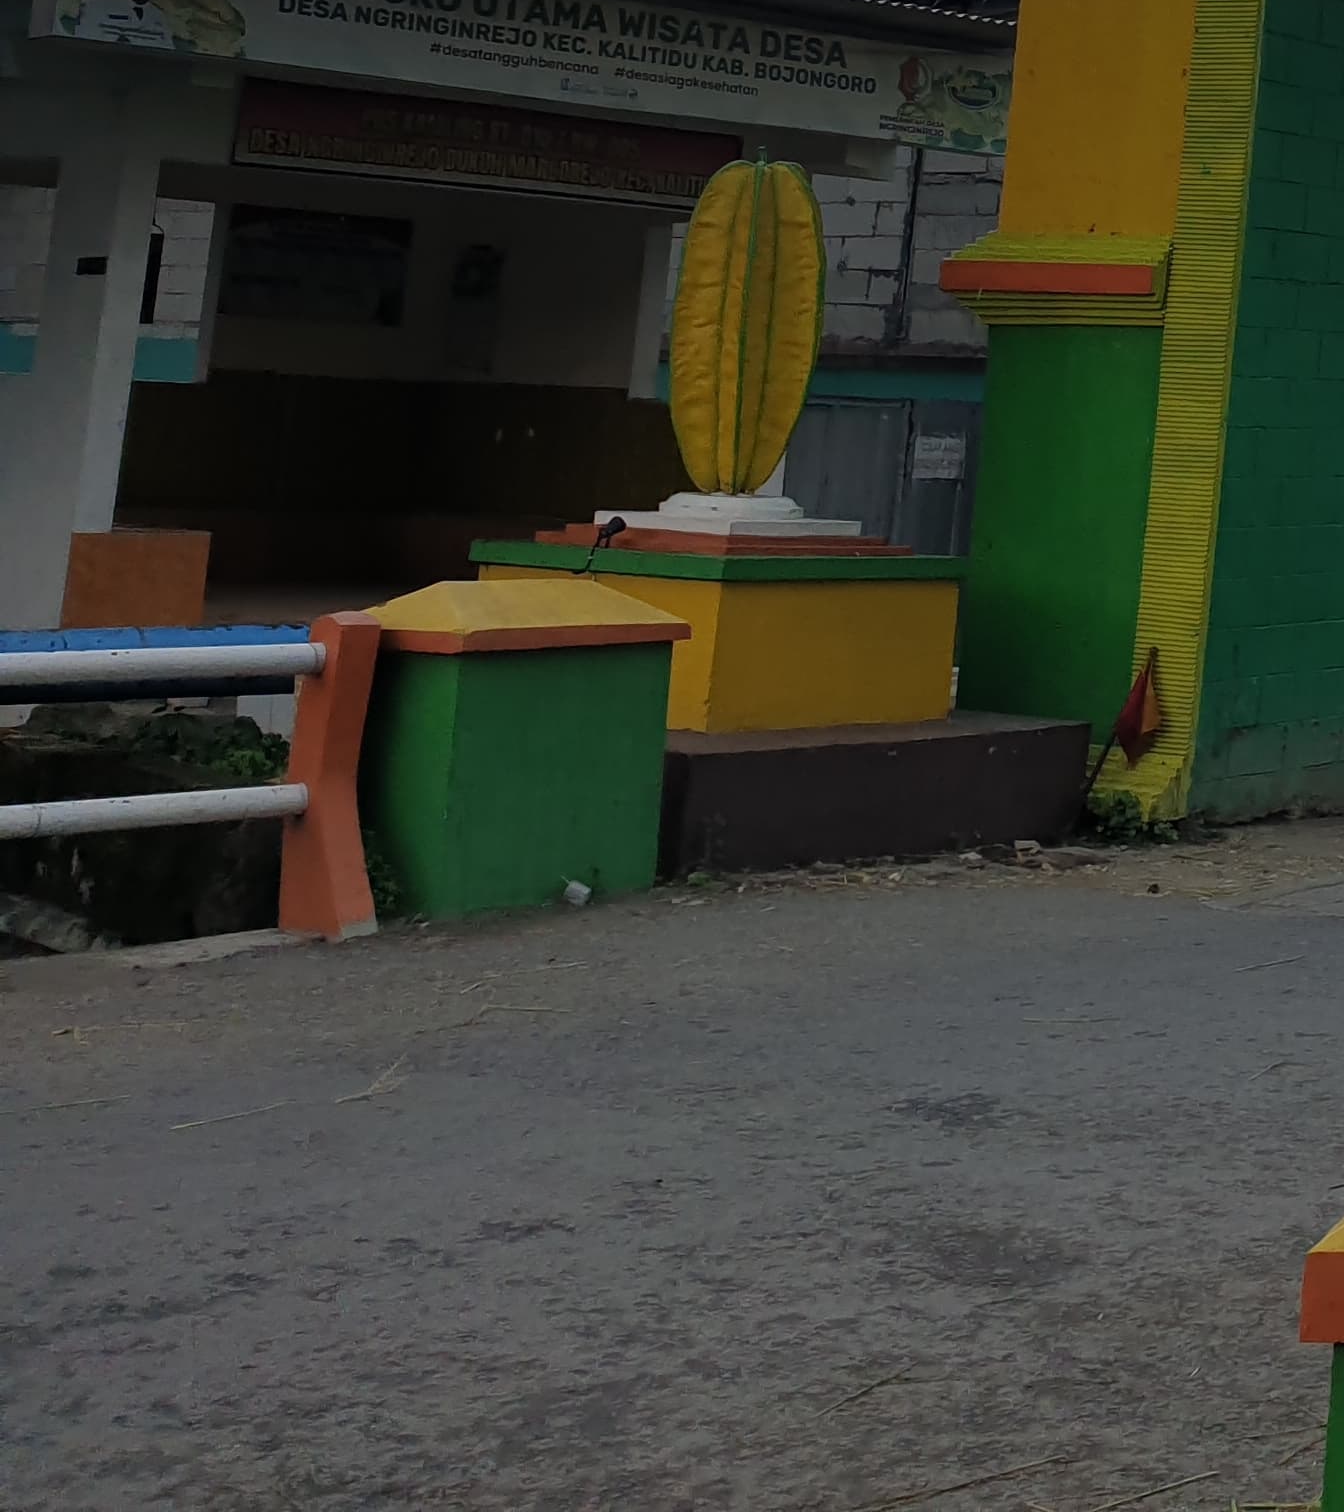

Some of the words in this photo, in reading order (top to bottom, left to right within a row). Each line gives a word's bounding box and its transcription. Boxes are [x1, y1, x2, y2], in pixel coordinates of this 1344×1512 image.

[353, 6, 536, 49] NGRINGINREJO
[542, 27, 592, 56] KEC.
[598, 40, 697, 70] KALITIDU
[702, 54, 750, 78] KAB.
[754, 62, 877, 95] BOJONGORO
[429, 42, 599, 76] #desatangguhbencana
[618, 7, 750, 56] WISATA
[759, 30, 848, 69] DESA
